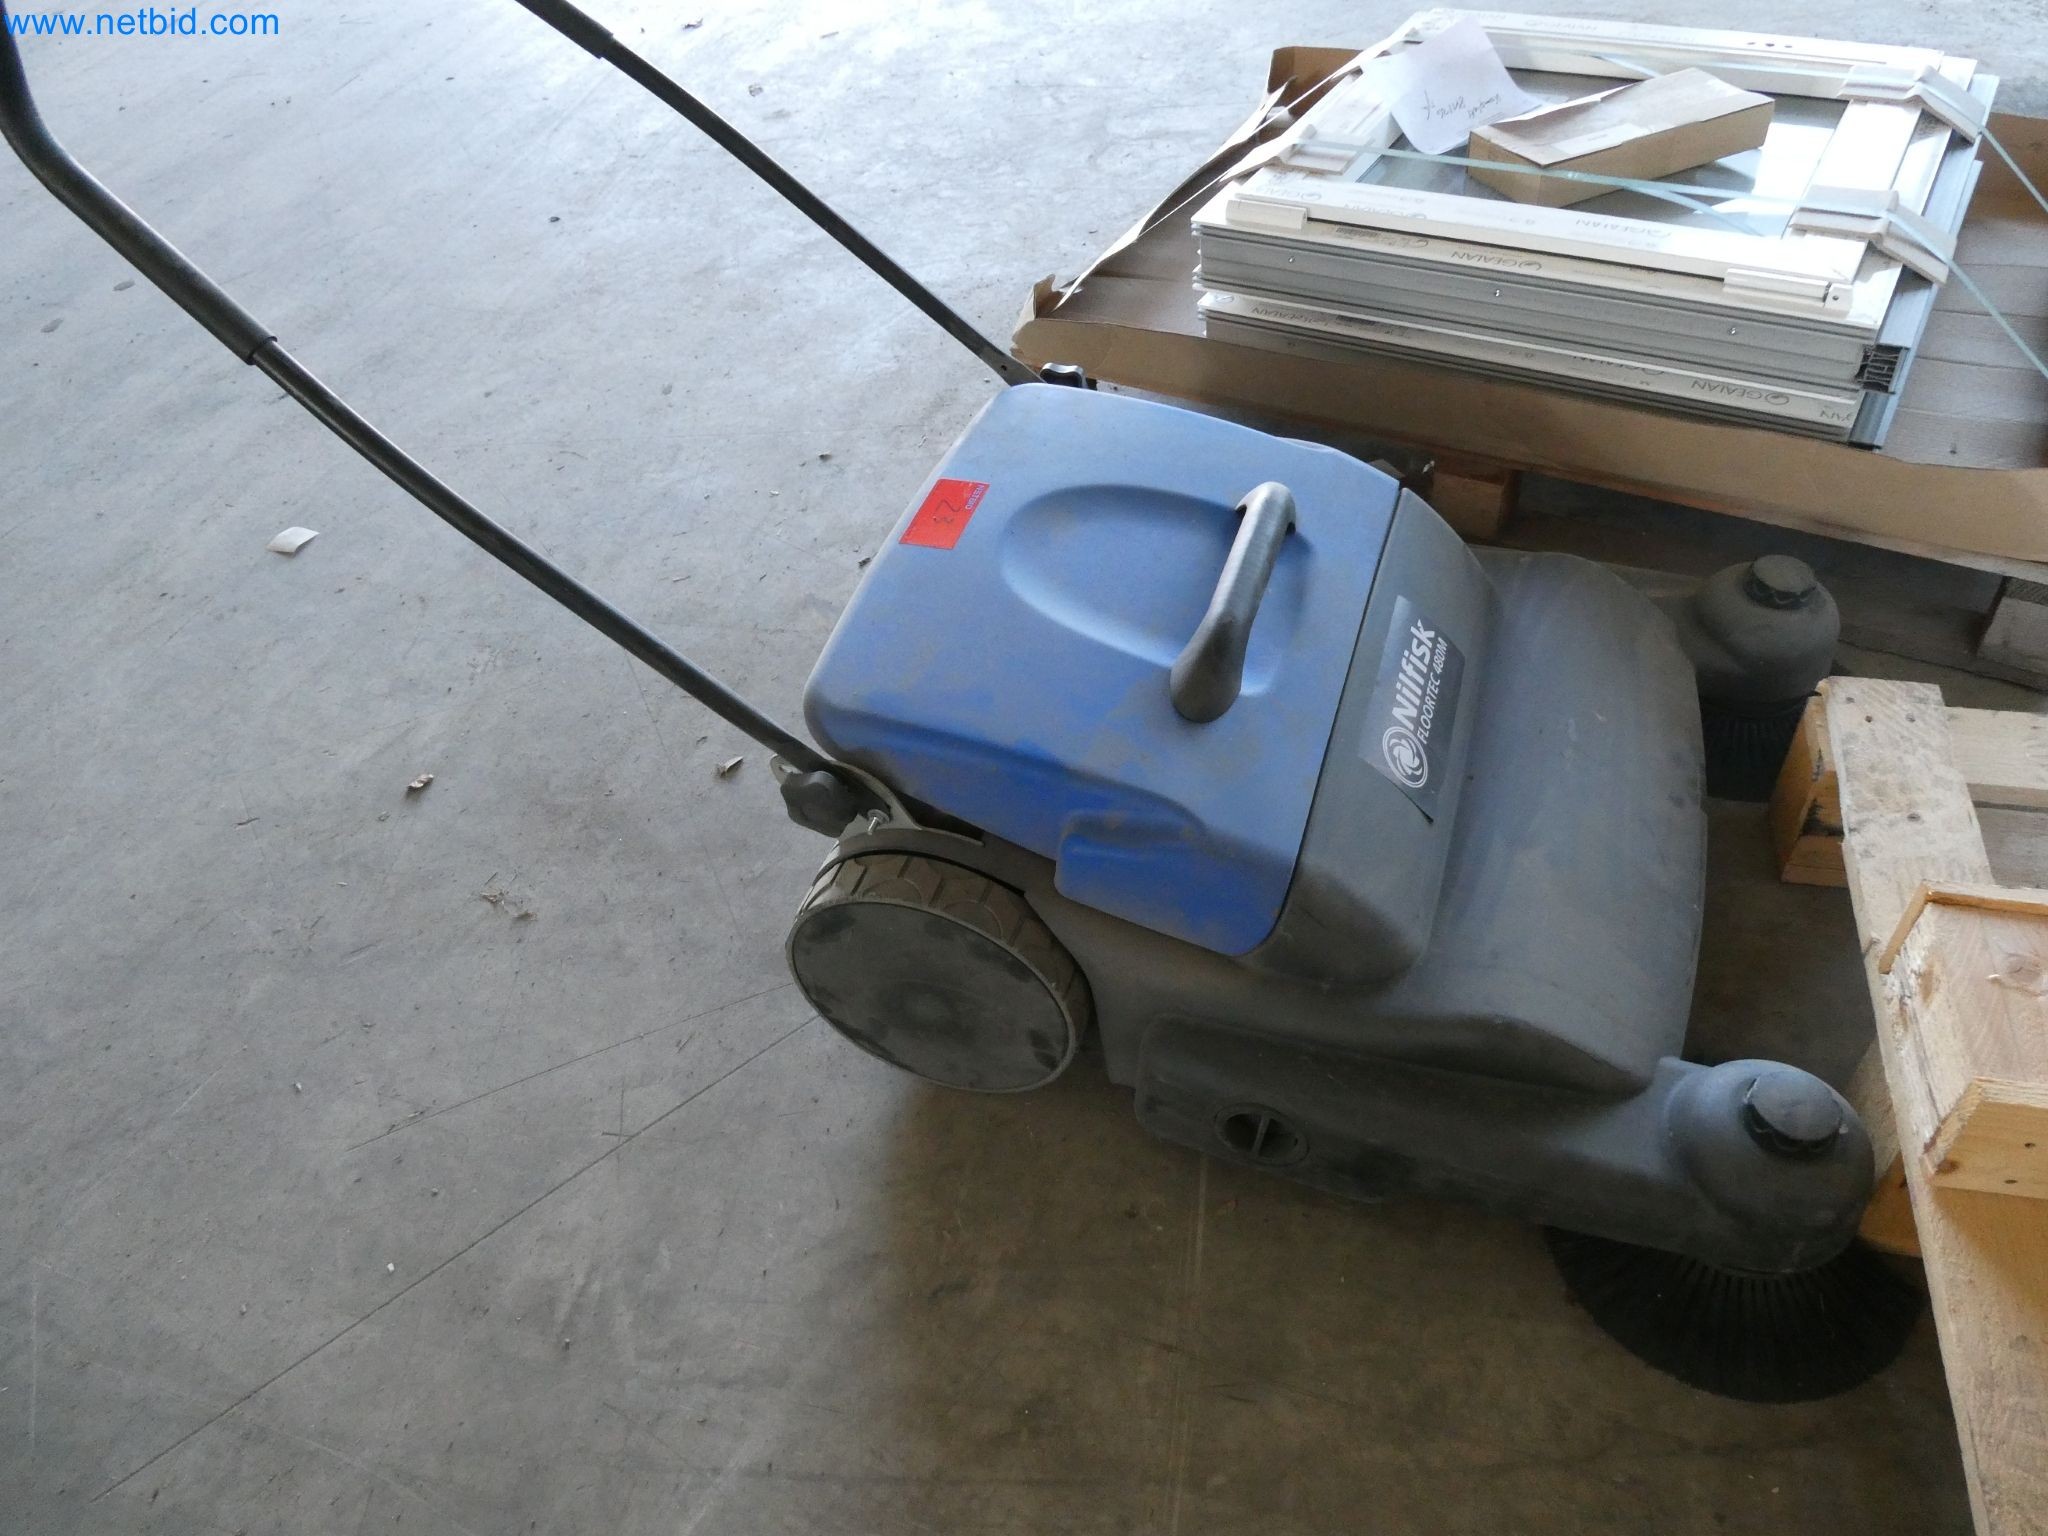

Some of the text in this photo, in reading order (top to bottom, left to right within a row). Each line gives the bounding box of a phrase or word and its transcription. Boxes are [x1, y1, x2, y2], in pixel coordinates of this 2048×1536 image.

[1691, 379, 1762, 399] GEALAN
[1391, 619, 1435, 731] Nilfisk
[1416, 636, 1448, 745] FLOORTEC 480M
